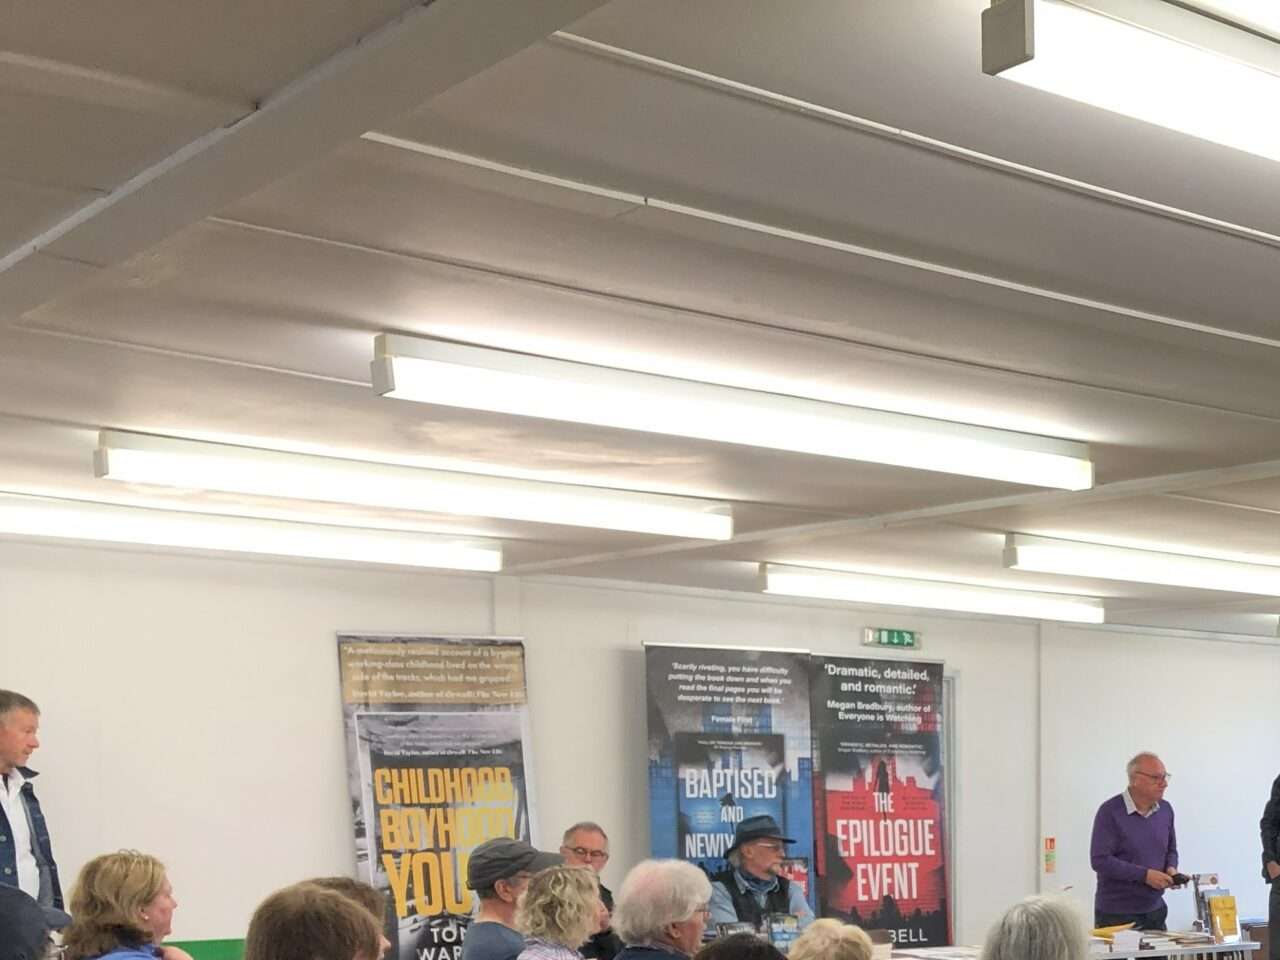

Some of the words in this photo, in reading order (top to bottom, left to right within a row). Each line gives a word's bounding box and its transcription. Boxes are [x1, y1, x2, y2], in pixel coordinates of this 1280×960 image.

[883, 667, 929, 682] detailed,
[840, 681, 862, 692] and
[827, 700, 855, 711] Megan
[896, 703, 921, 712] author
[838, 711, 875, 722] Everyone
[877, 713, 884, 721] is
[375, 766, 514, 805] CHILDHOOD
[685, 767, 777, 799] BAPTISED
[873, 791, 895, 813] THE
[720, 805, 744, 824] AND
[836, 818, 936, 857] EPILOGUE
[857, 862, 919, 901] EVENT
